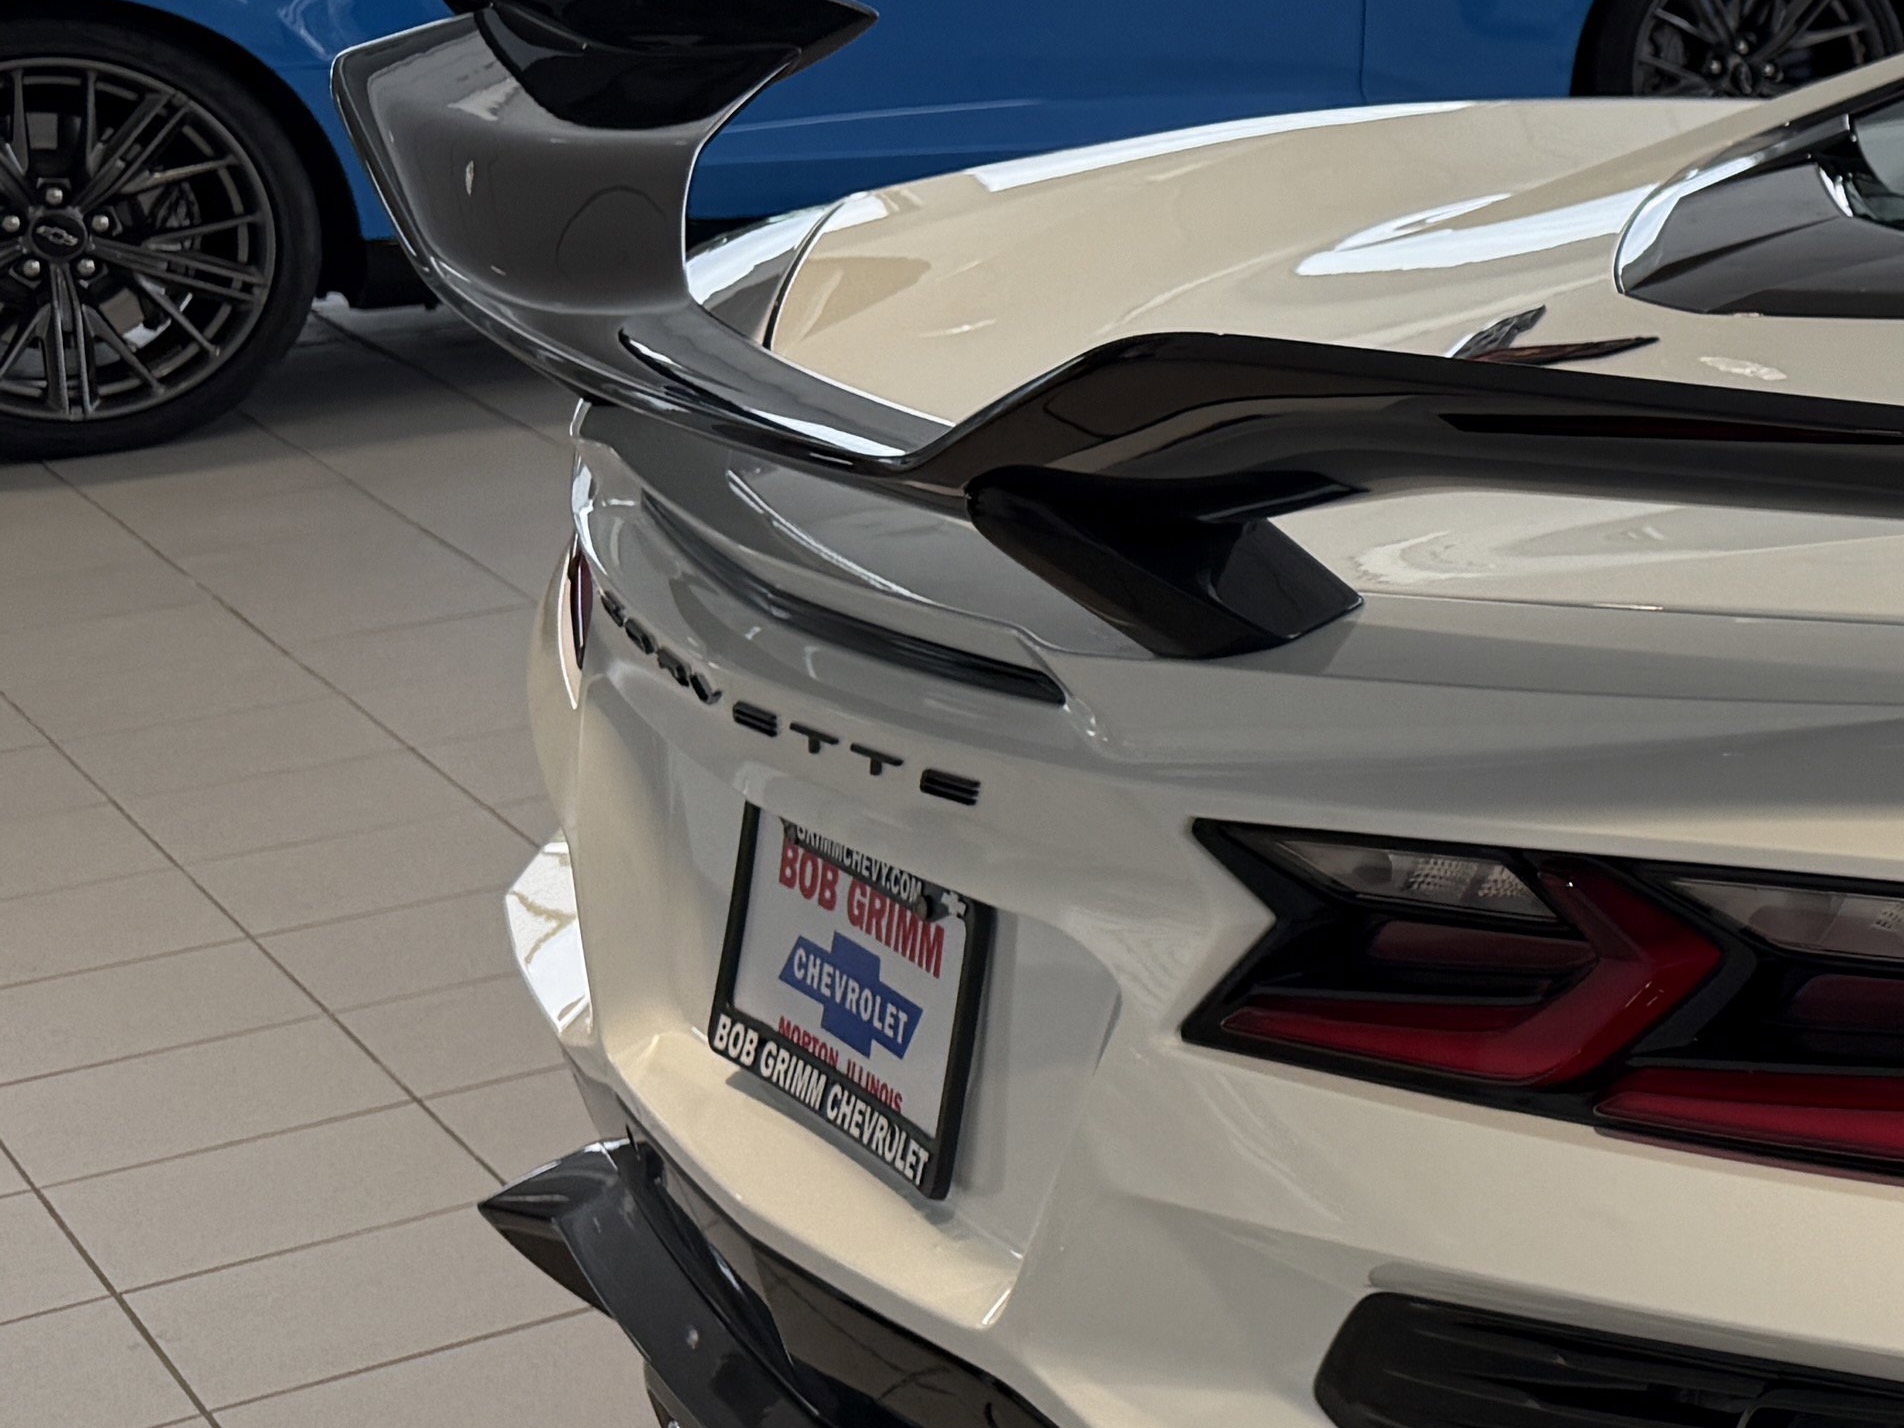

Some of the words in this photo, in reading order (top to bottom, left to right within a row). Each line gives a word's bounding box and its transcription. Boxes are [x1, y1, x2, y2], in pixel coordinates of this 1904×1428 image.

[601, 589, 981, 807] CORVETTE
[779, 840, 839, 911] BOB
[847, 877, 945, 979] GRIMM
[779, 1015, 838, 1068] MORTON
[847, 1058, 903, 1112] ILLINOIS
[793, 948, 908, 1044] CHEVROLET
[713, 1014, 759, 1067] BOB
[760, 1041, 828, 1111] GRIMM
[826, 1083, 929, 1186] CHEVROLET
